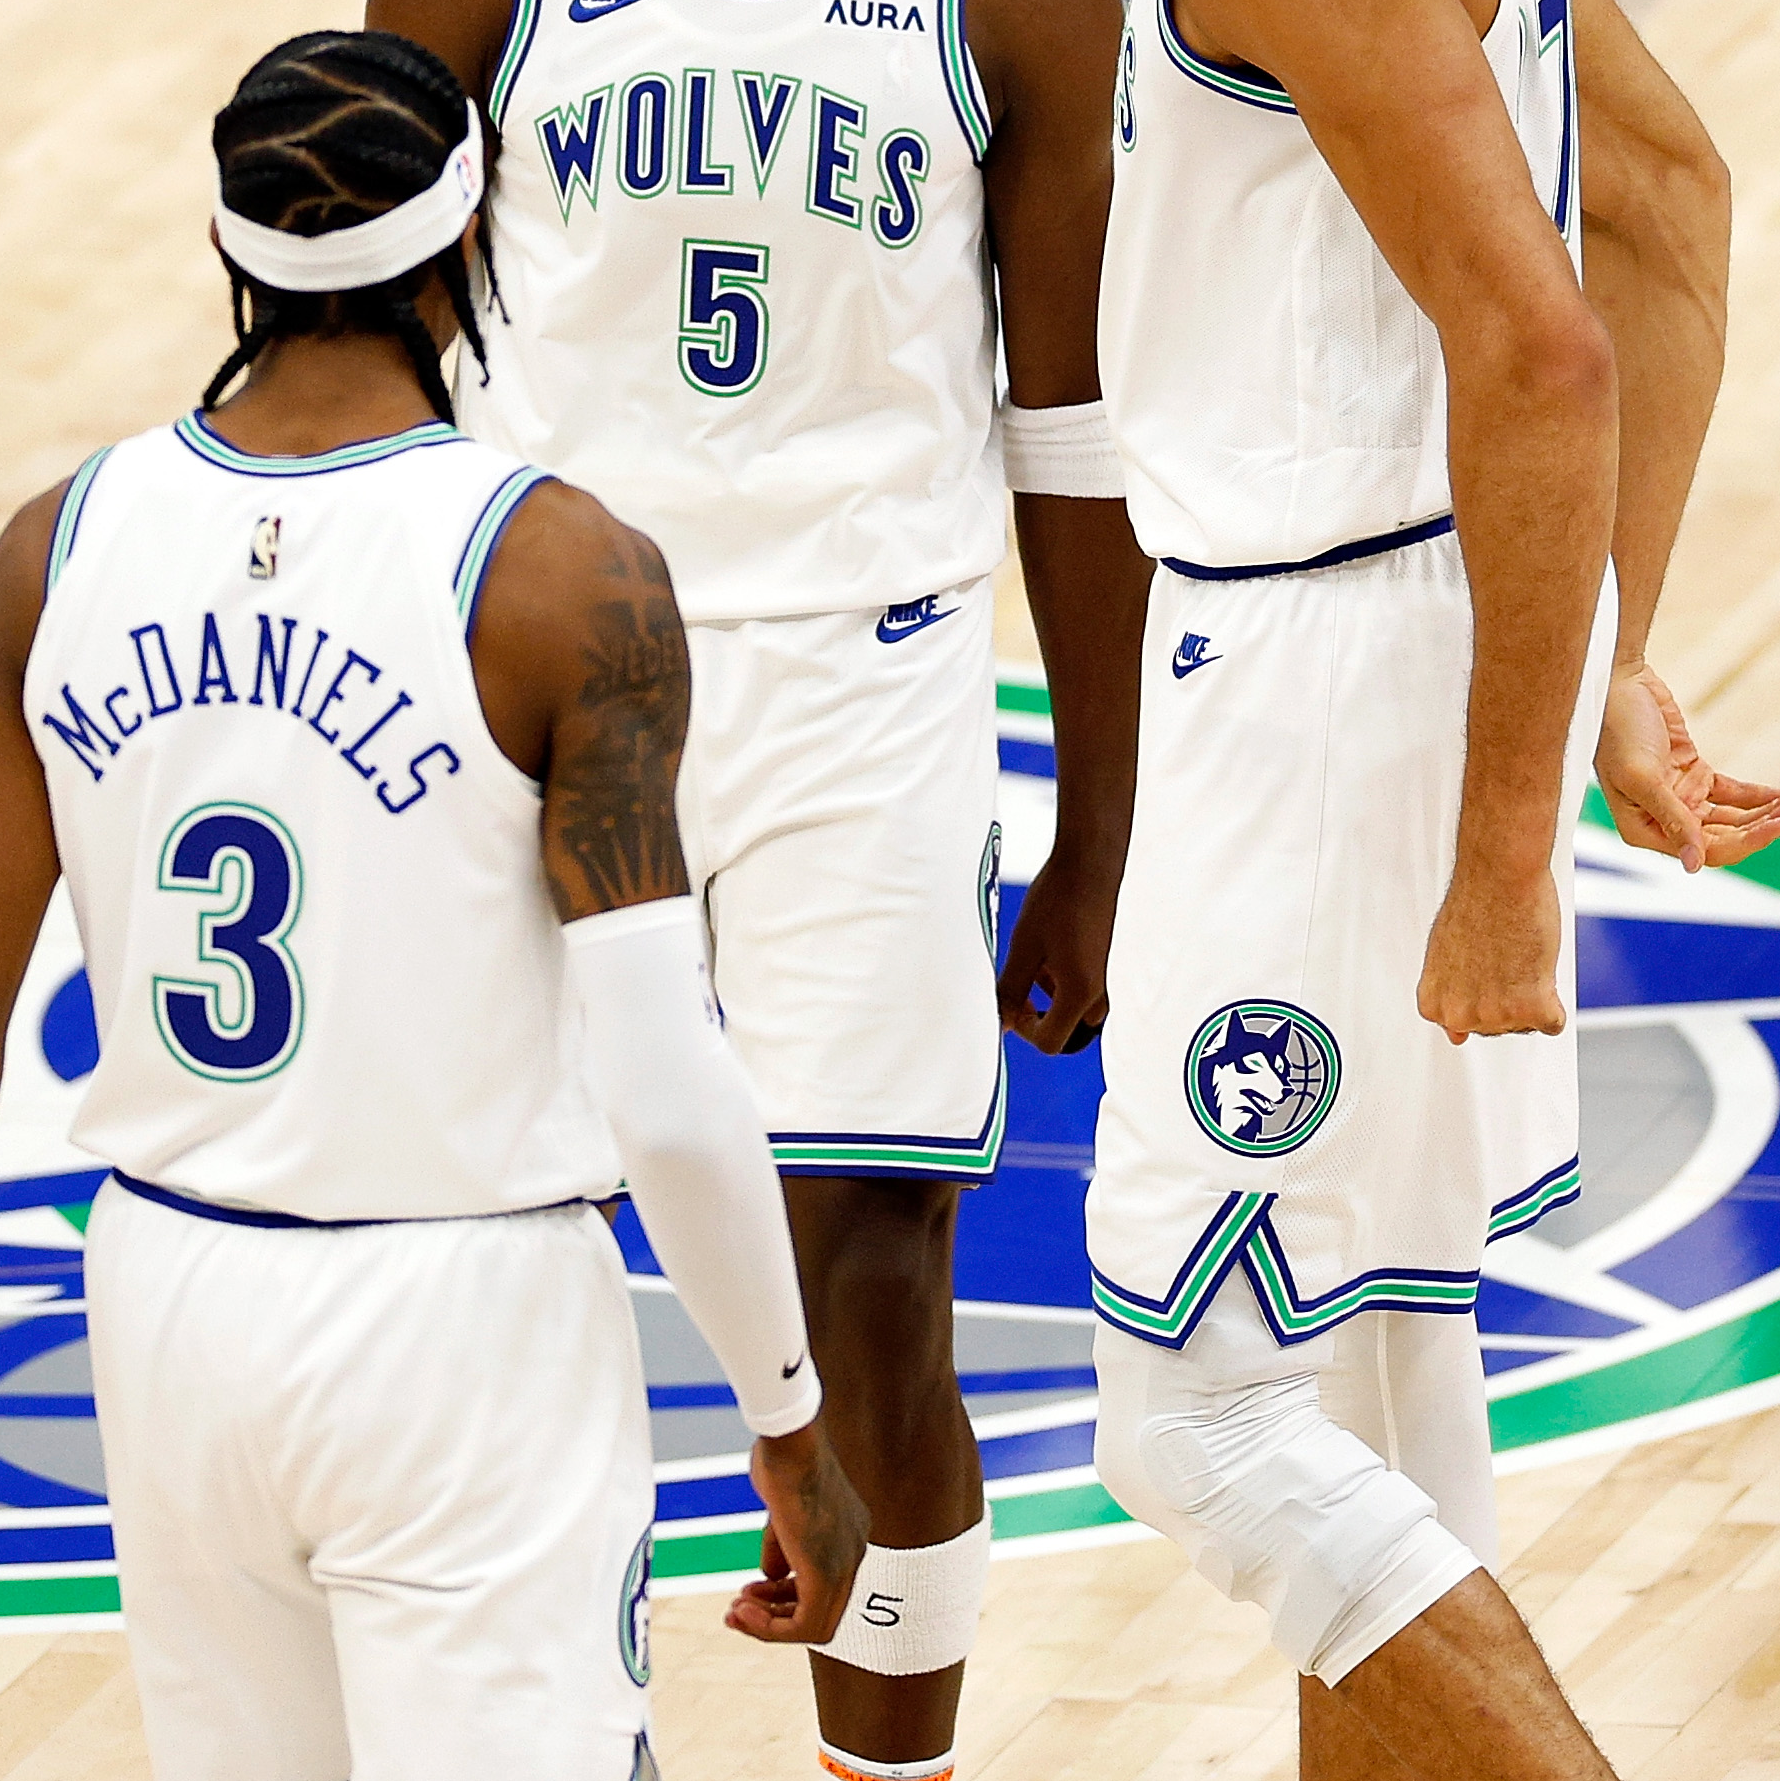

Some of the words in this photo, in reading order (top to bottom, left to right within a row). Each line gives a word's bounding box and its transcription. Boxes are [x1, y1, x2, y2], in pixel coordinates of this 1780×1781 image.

[535, 68, 931, 251] WOLVES
[678, 238, 769, 398] 5
[886, 594, 939, 623] NIKE
[43, 612, 461, 814] McDANIELS
[153, 800, 305, 1083] 3
[860, 1592, 904, 1627] 5
